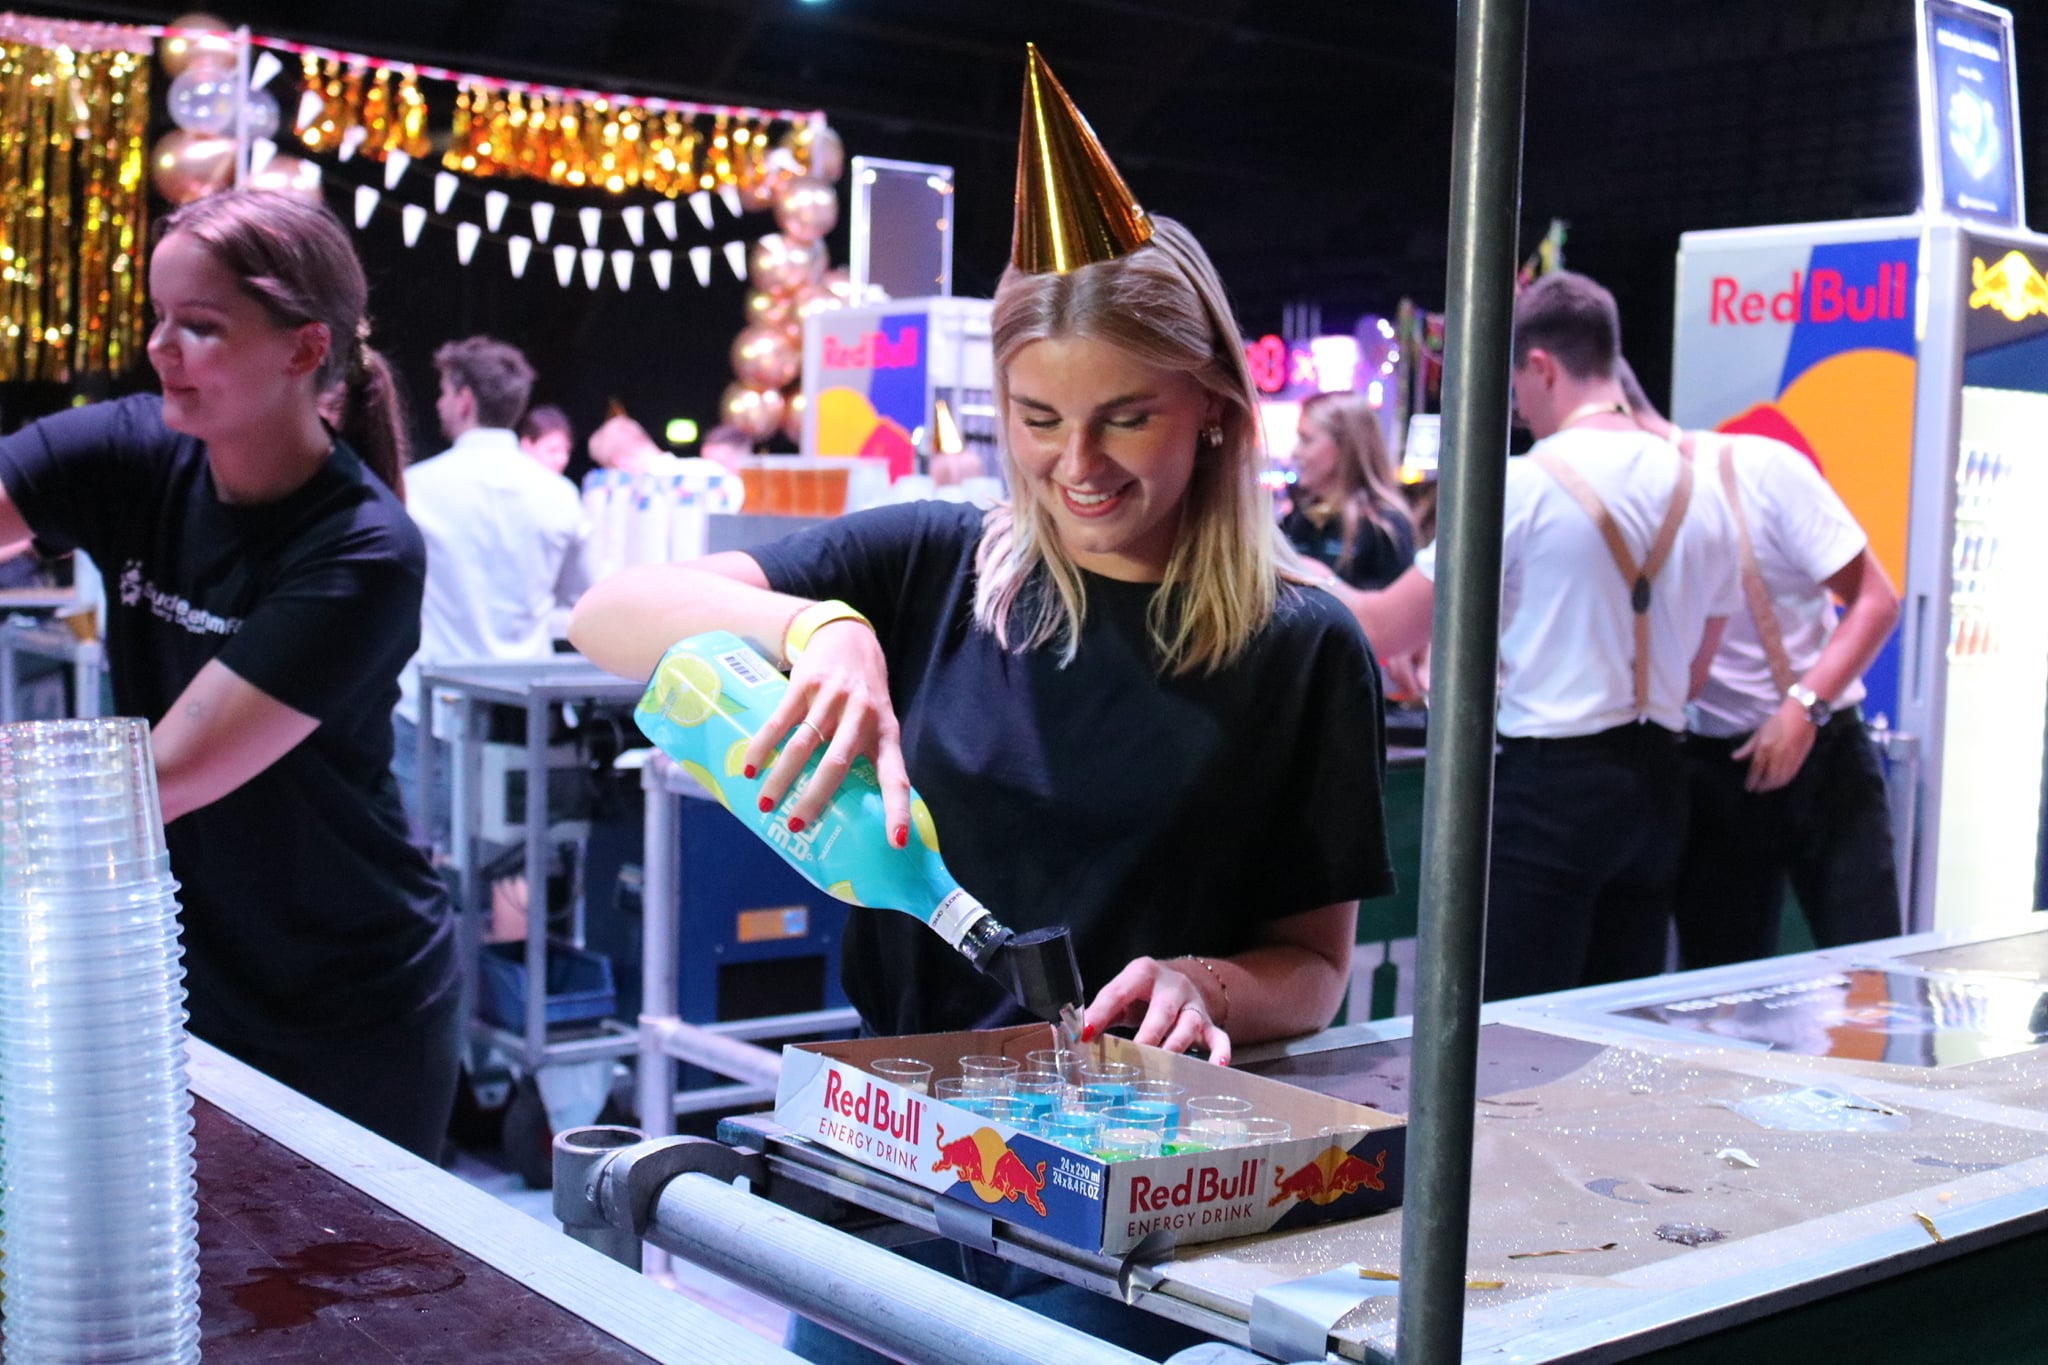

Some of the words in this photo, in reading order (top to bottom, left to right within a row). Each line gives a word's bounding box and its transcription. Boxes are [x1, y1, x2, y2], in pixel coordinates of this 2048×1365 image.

[1709, 269, 1803, 327] Red
[1808, 261, 1908, 324] Bull
[823, 1068, 872, 1125] Red
[873, 1087, 921, 1146] Bull
[818, 1117, 873, 1153] ENERGY
[876, 1140, 918, 1173] DRINK
[1129, 1167, 1194, 1214] Red
[1197, 1158, 1258, 1204] Bull
[1127, 1211, 1196, 1238] ENERGY
[1202, 1202, 1254, 1226] DRINK
